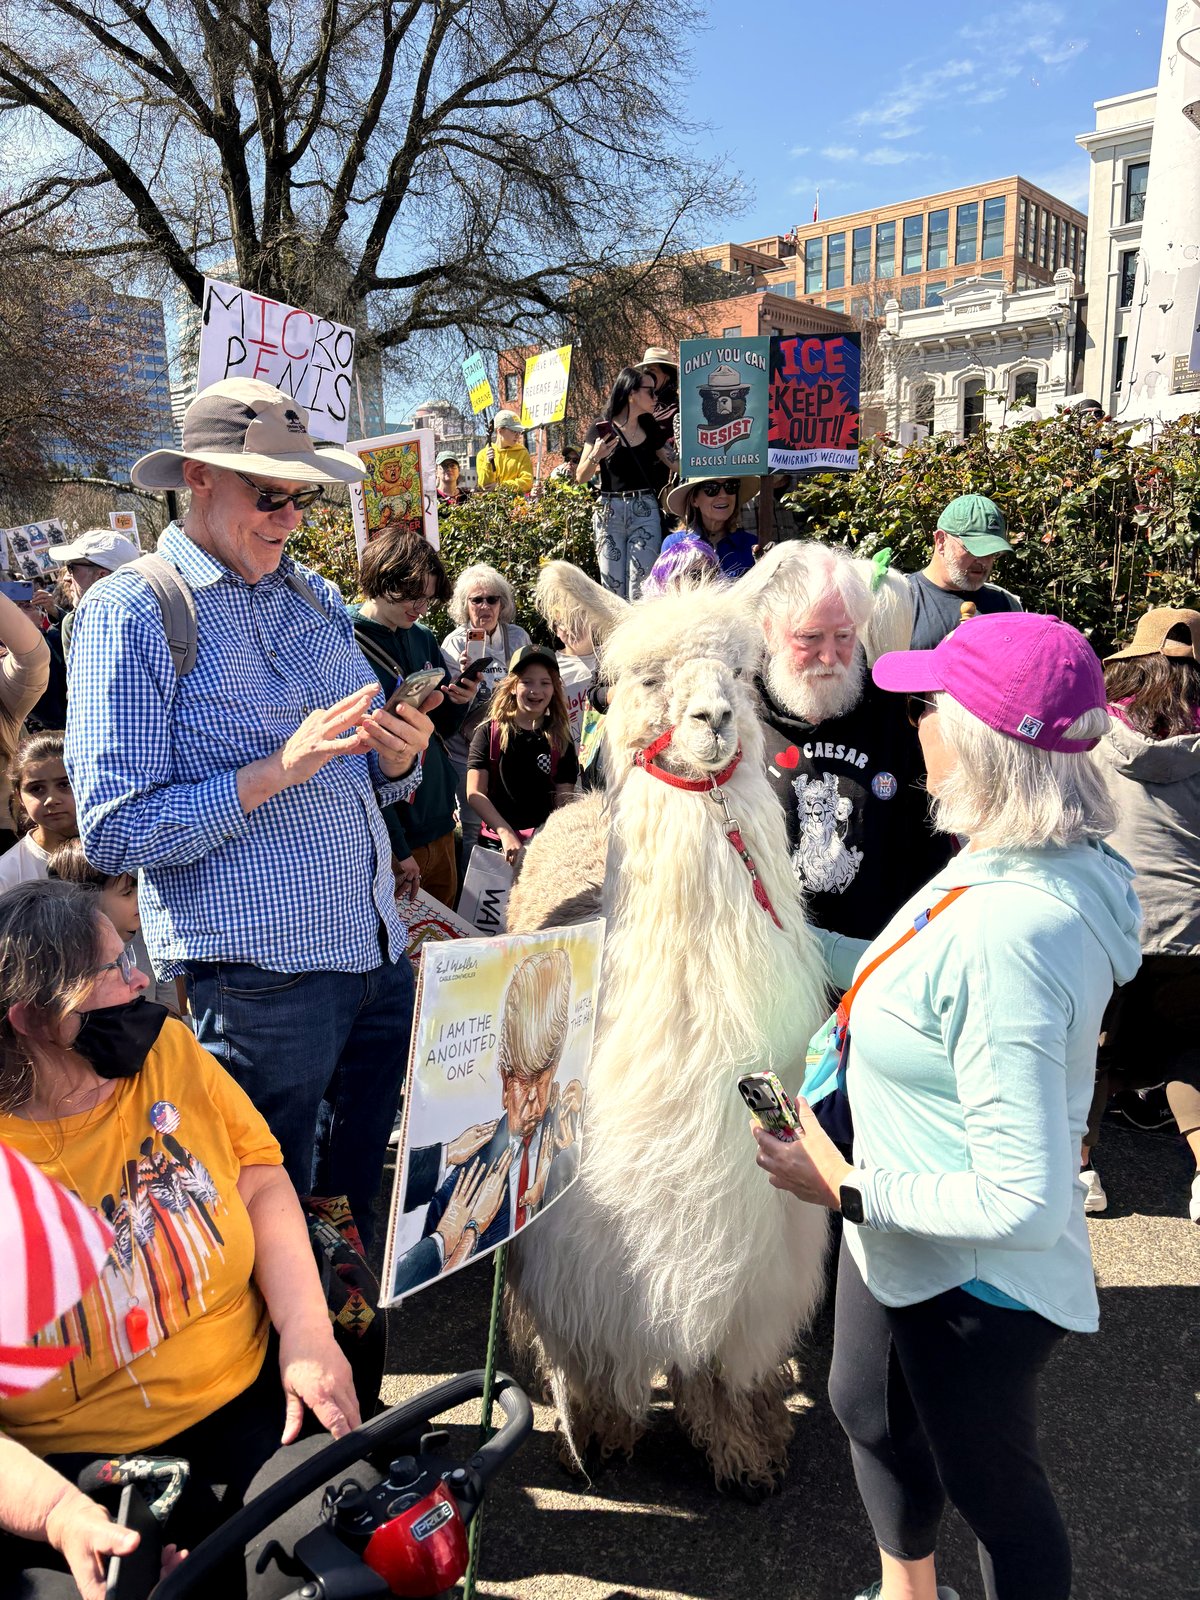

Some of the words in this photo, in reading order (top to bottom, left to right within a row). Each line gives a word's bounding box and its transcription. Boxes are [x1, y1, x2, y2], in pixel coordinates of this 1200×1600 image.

[203, 285, 354, 370] MICRO
[464, 358, 484, 379] STAND
[684, 350, 713, 375] ONLY
[716, 348, 740, 363] YOU
[745, 351, 766, 372] CAN
[779, 336, 847, 375] ICE
[223, 335, 352, 422] PENIS
[469, 375, 489, 396] WITH
[525, 381, 551, 397] RELEASE
[553, 379, 566, 392] ALL
[525, 404, 540, 421] THE
[543, 399, 564, 419] FILES
[774, 384, 834, 420] KEEP
[700, 419, 752, 446] RESIST
[789, 414, 845, 447] OUT!!
[690, 454, 728, 466] FASCIST
[731, 453, 761, 465] LIARS
[771, 452, 818, 465] IMMIGRANTS
[820, 451, 856, 465] WELCOME
[768, 765, 781, 779] I
[803, 741, 869, 769] CAESAR
[879, 786, 892, 794] NO
[439, 1023, 444, 1042] I
[446, 1020, 465, 1039] AM
[468, 1014, 492, 1033] THE
[426, 1033, 497, 1066] ANOINTED
[447, 1059, 475, 1081] ONE
[415, 1505, 451, 1536] PRIDE
